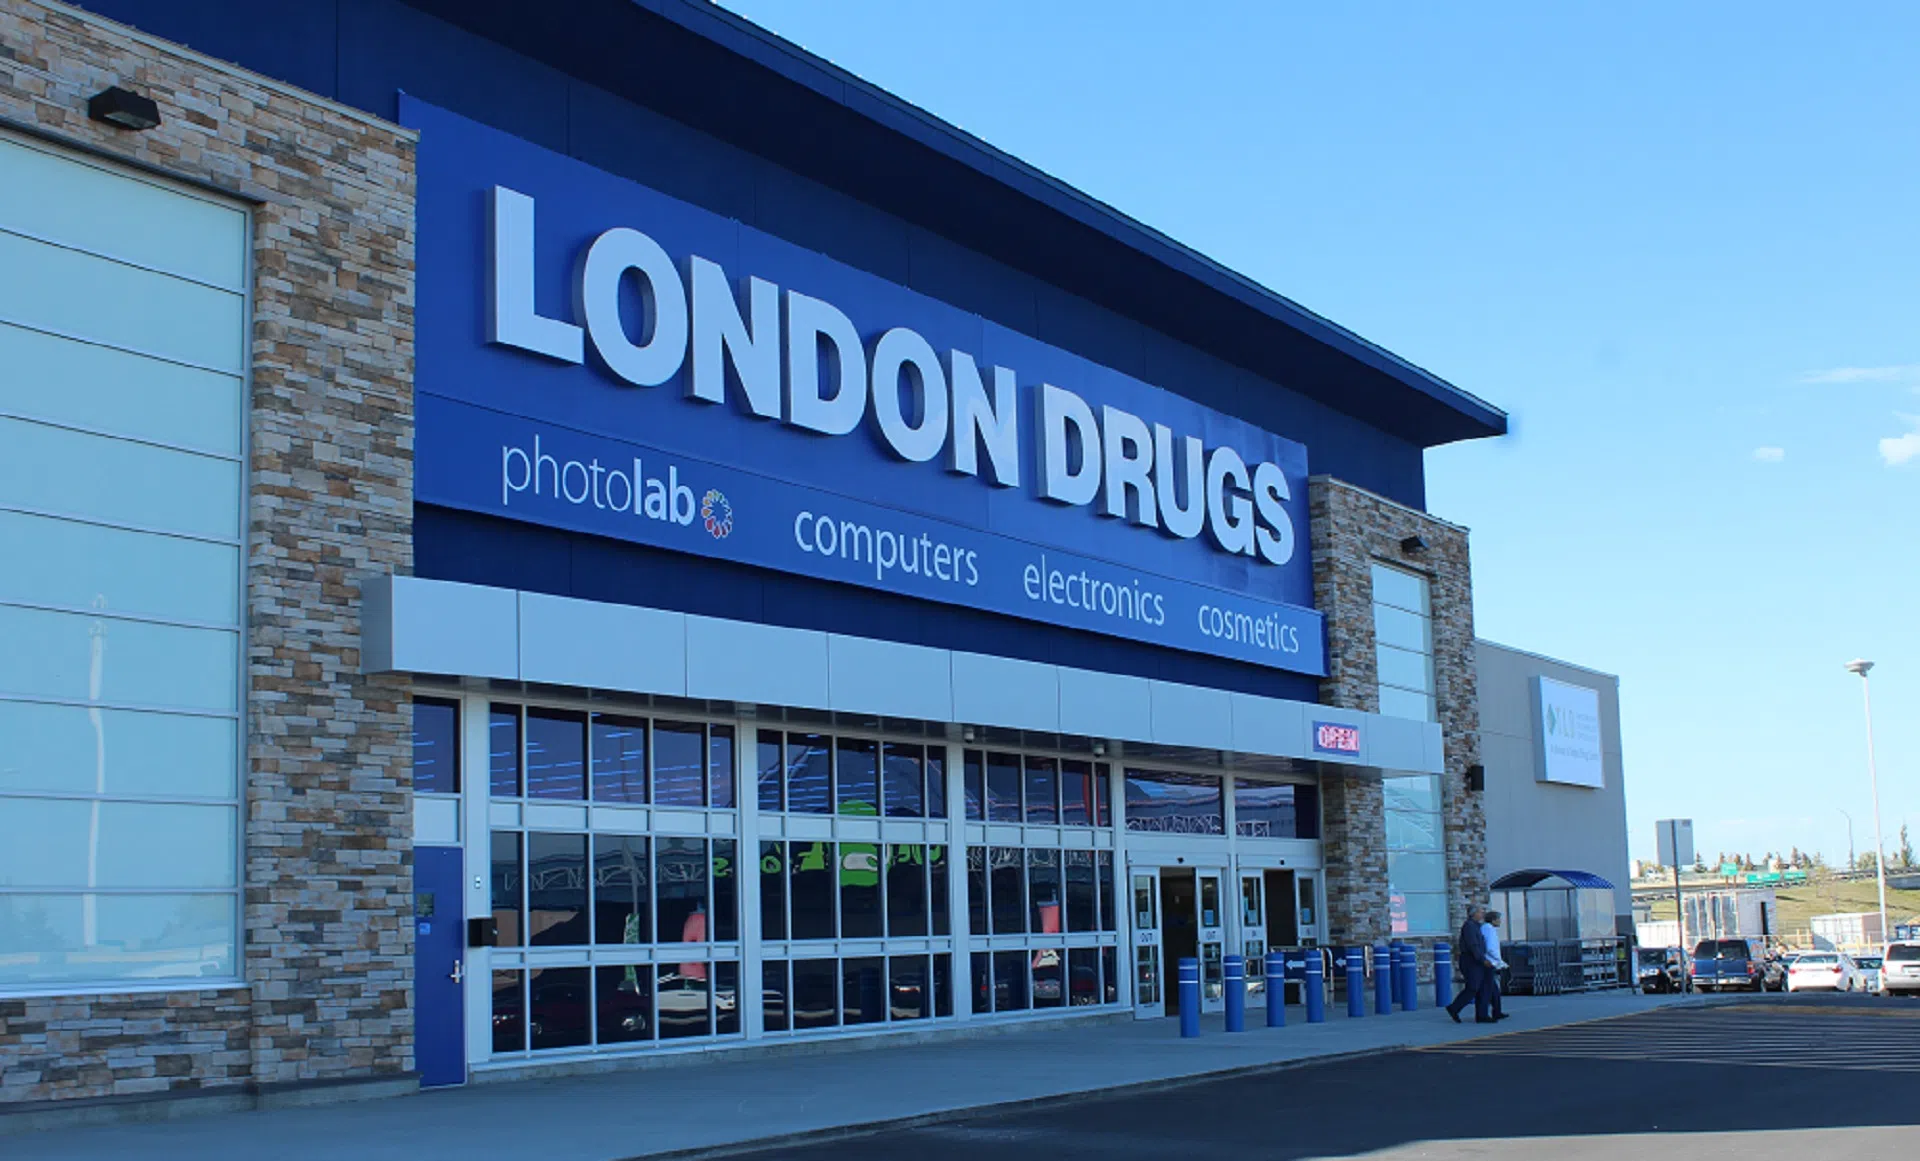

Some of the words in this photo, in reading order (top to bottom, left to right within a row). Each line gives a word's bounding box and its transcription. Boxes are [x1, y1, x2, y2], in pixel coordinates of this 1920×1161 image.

[492, 184, 1019, 488] LONDON
[1040, 383, 1295, 566] DRUGS
[502, 434, 696, 527] photolab
[794, 511, 980, 587] computers
[1023, 554, 1166, 627] electronics
[1198, 604, 1300, 654] cosmetics
[1318, 724, 1360, 752] OPEN
